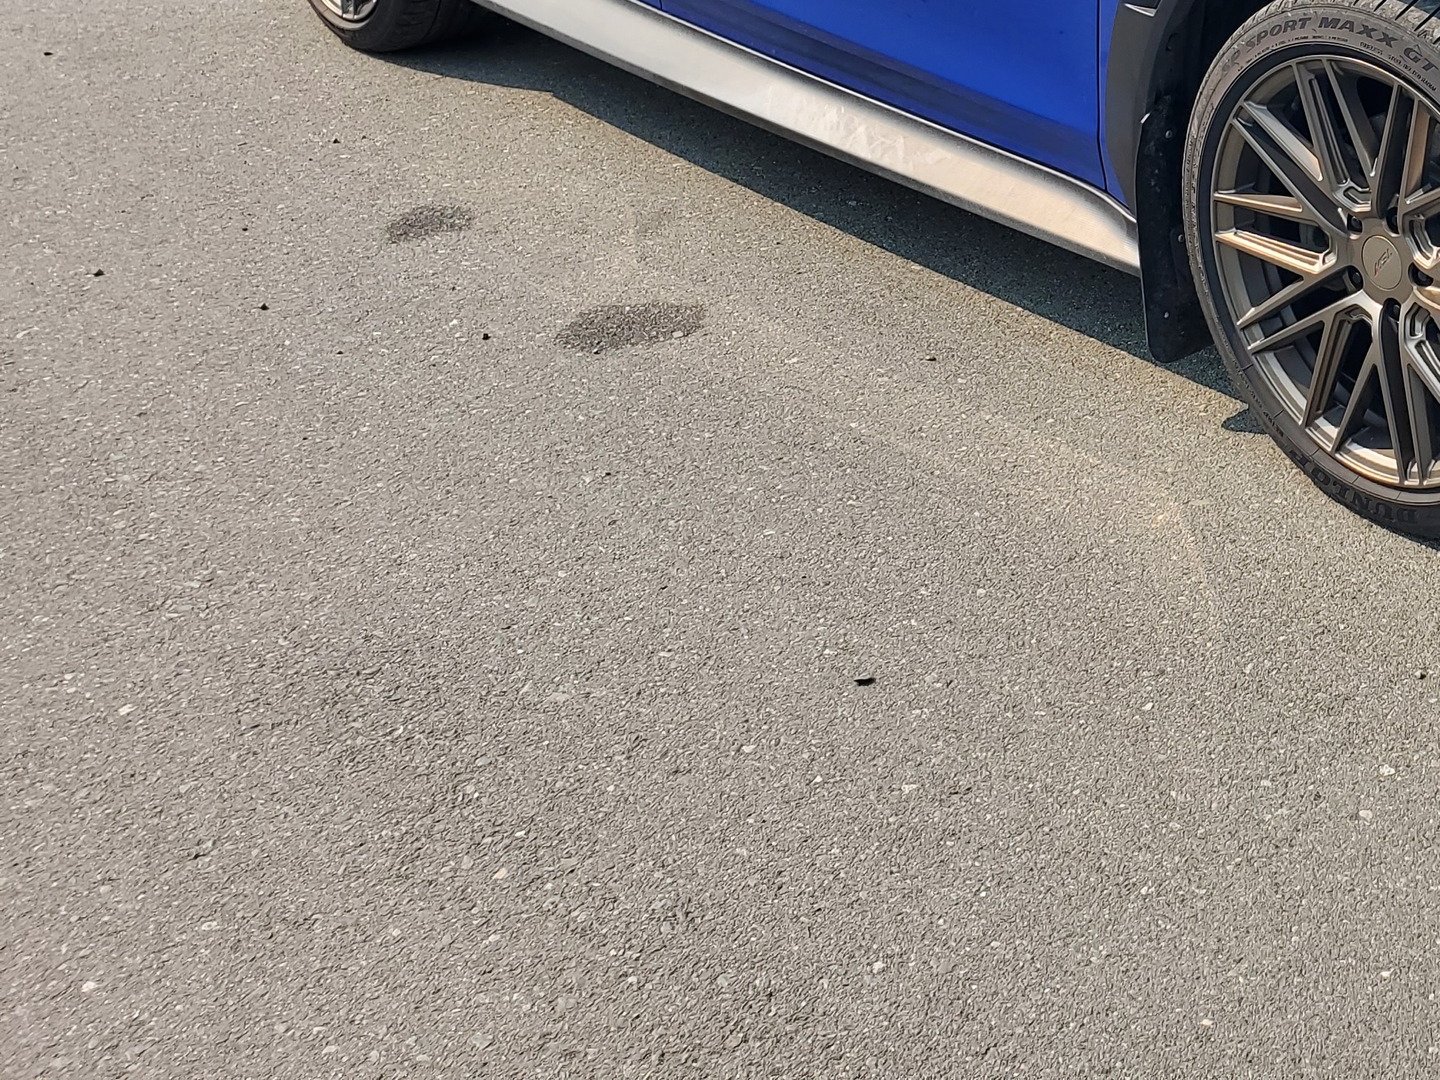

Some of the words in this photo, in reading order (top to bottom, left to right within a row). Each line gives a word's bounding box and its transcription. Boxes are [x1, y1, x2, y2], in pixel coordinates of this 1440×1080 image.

[1245, 17, 1312, 52] SPORT
[1318, 16, 1398, 48] MAXX
[1403, 46, 1439, 72] GT
[1289, 448, 1418, 525] DUNLOP
